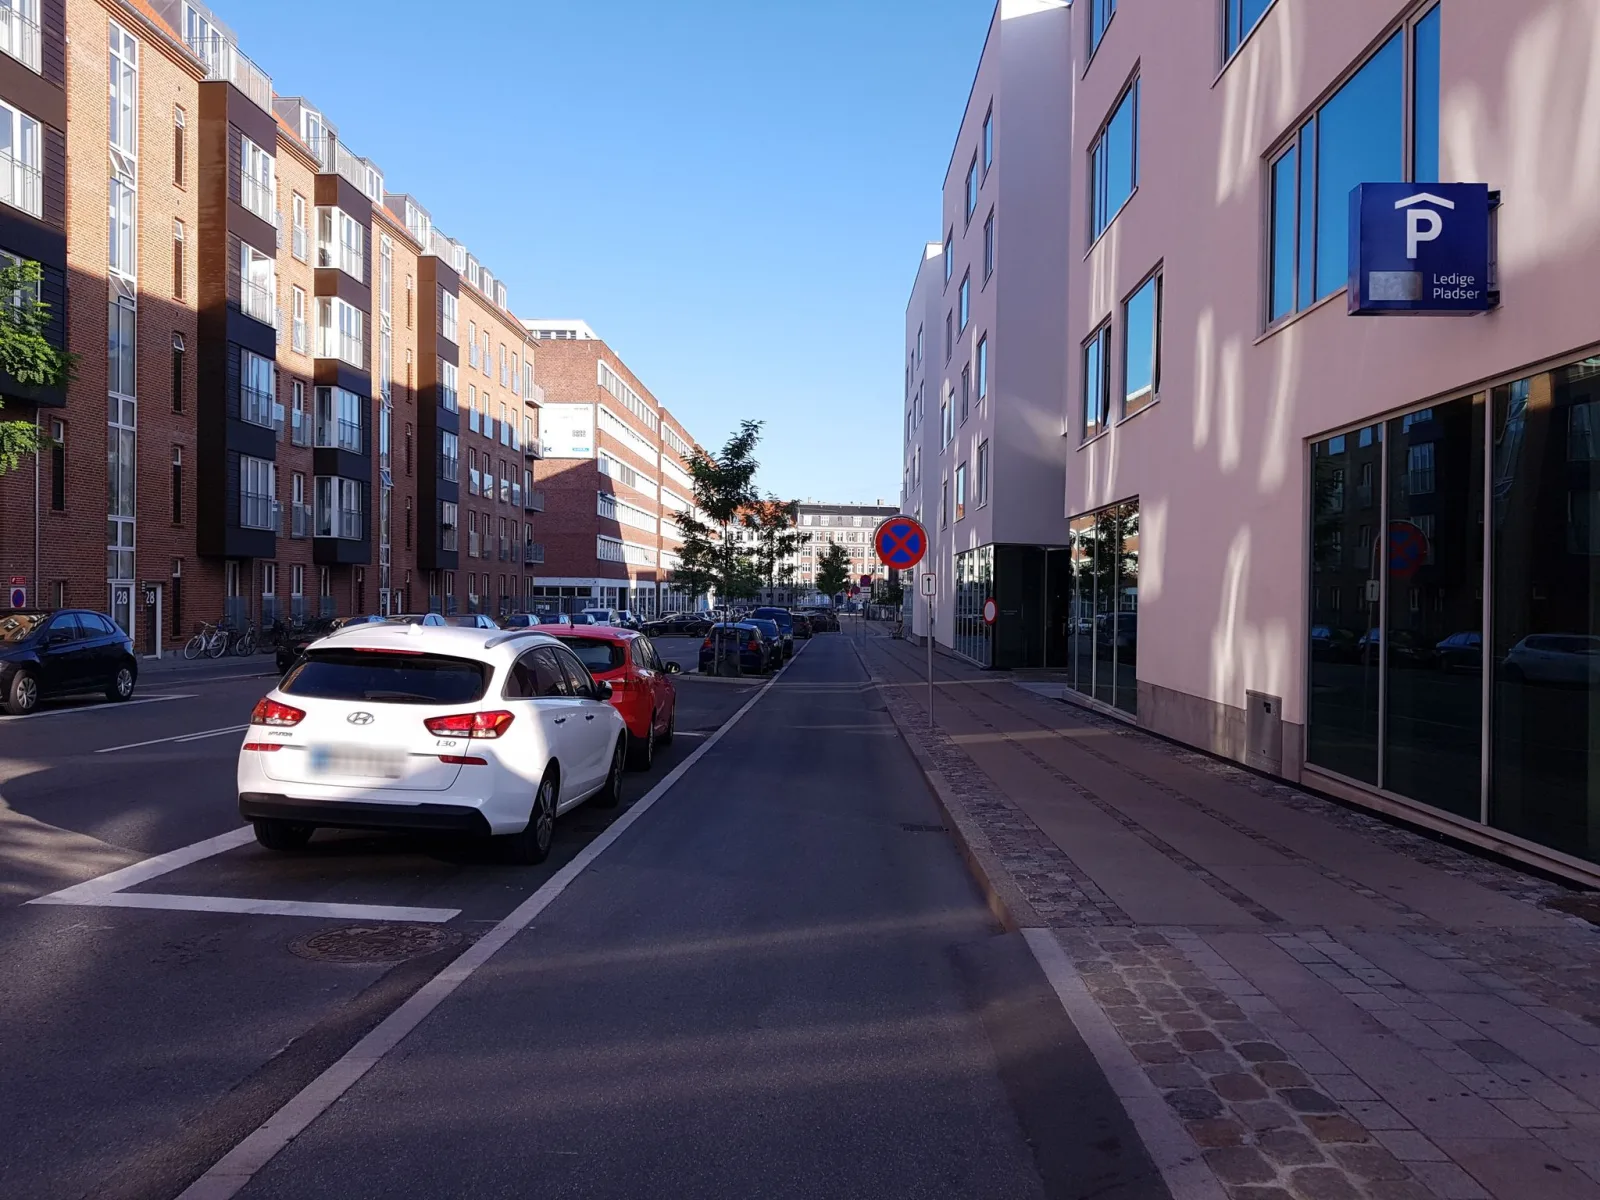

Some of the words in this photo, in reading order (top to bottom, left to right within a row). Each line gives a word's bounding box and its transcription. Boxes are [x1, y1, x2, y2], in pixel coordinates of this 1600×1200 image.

[1406, 208, 1443, 259] P
[1433, 273, 1475, 287] Ledige
[1433, 287, 1480, 300] Pladser
[116, 590, 128, 605] 28
[145, 591, 155, 604] 28
